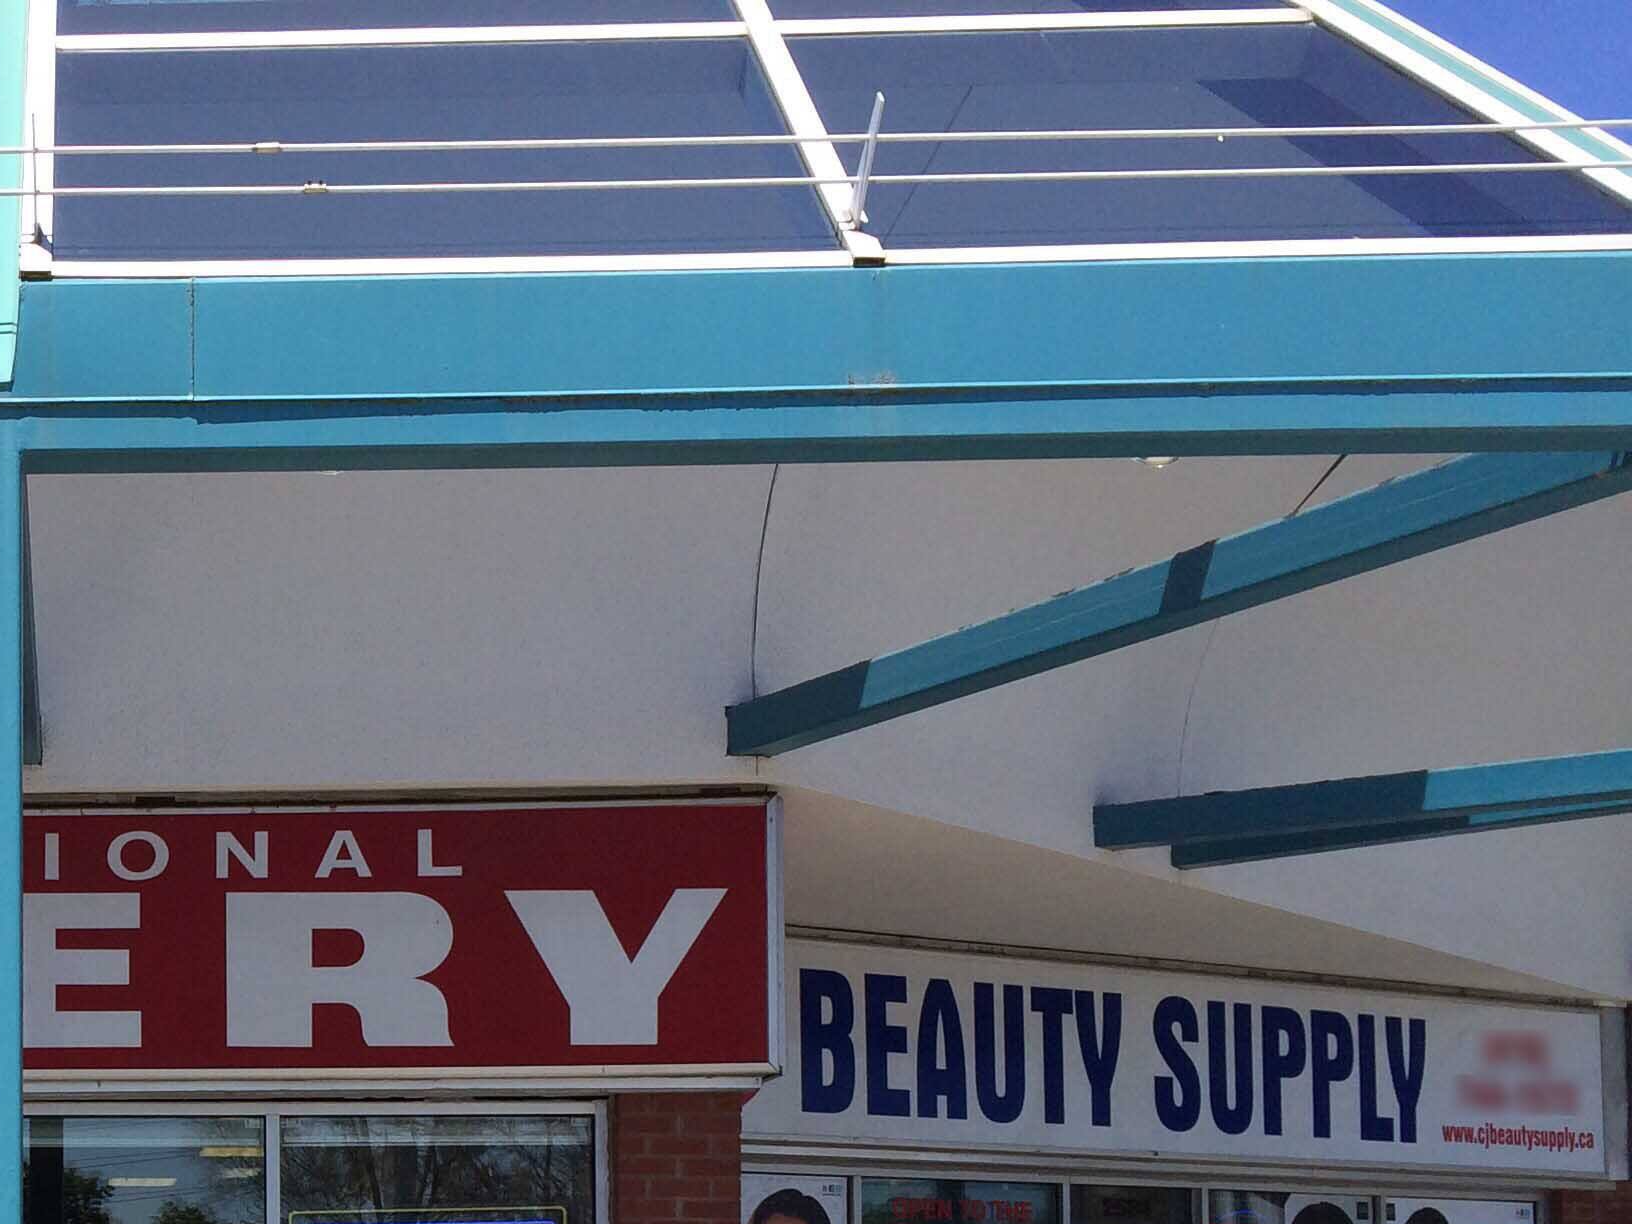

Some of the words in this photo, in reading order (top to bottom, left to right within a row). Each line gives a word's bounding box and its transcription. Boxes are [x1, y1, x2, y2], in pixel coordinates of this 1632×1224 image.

[800, 967, 1122, 1128] BEAUTY
[1153, 995, 1427, 1144] SUPPLY
[1441, 1122, 1595, 1152] www.cjbeautysupply.ca
[892, 1197, 953, 1219] OPEN
[990, 1199, 1033, 1222] THE
